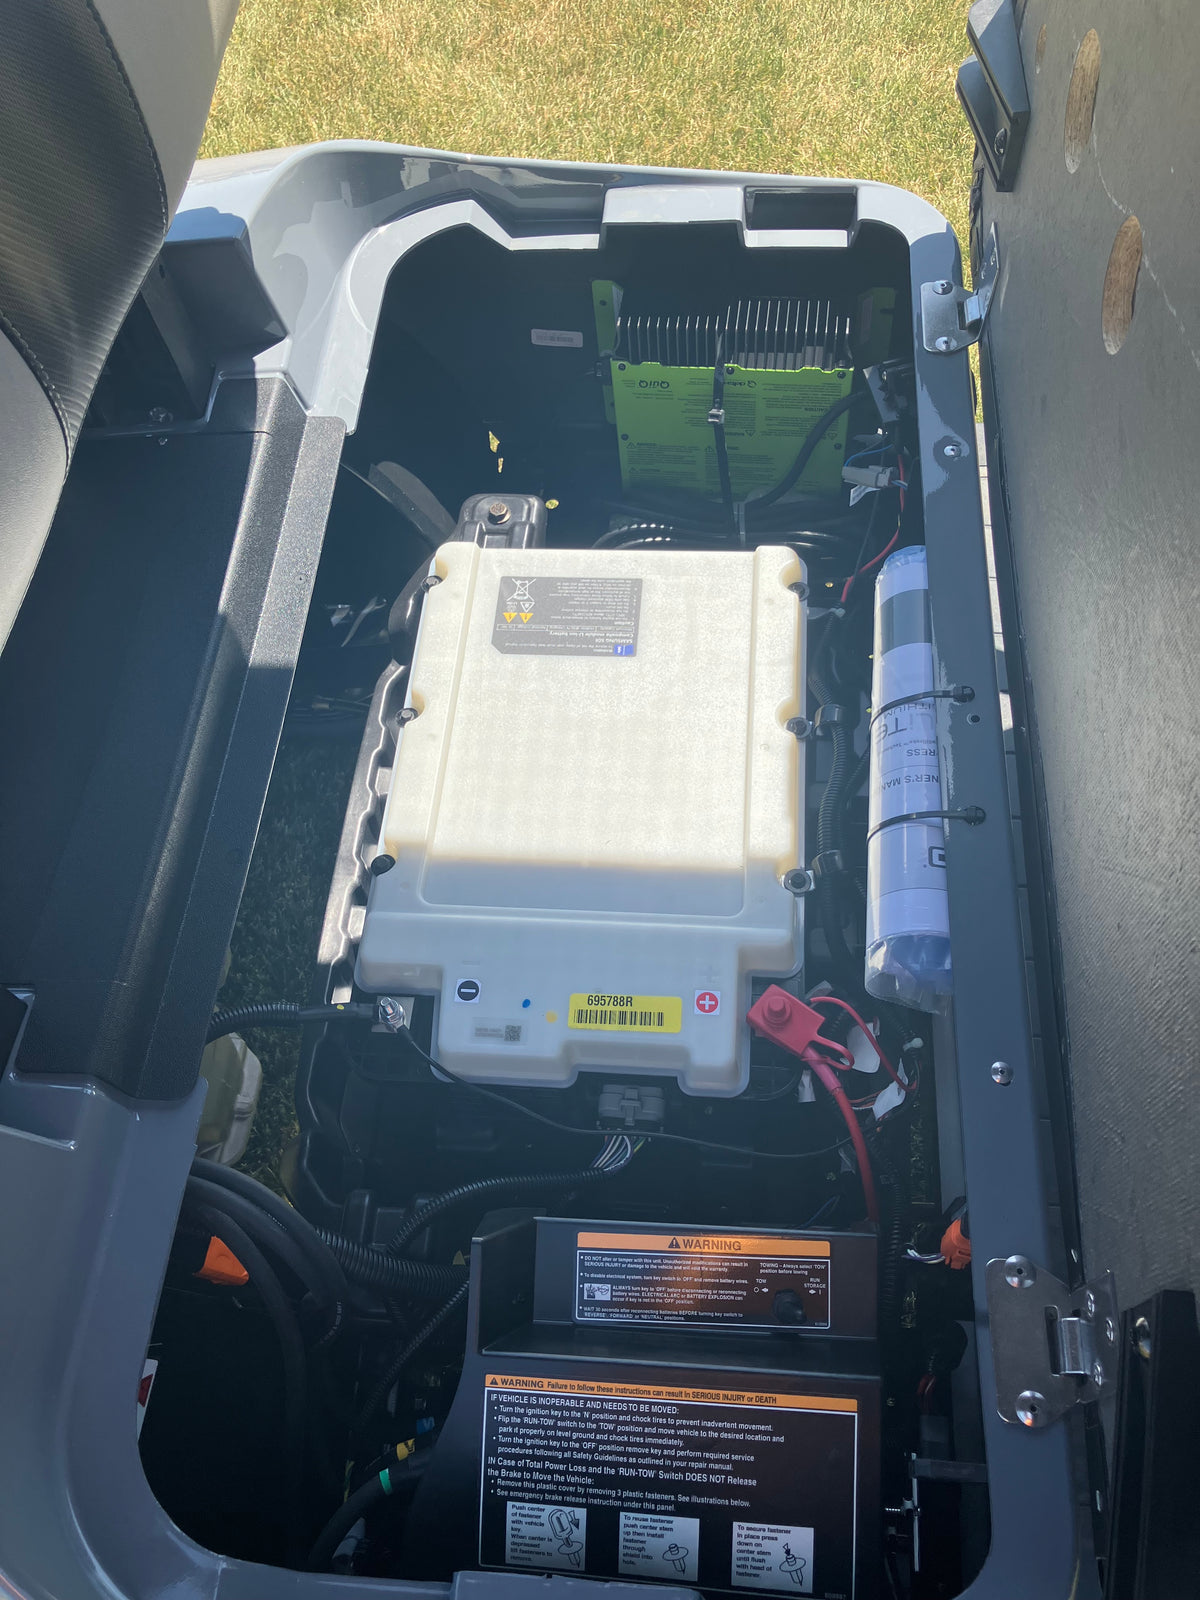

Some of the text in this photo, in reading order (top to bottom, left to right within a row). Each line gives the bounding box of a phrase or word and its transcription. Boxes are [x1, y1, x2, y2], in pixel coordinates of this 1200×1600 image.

[587, 995, 633, 1007] 695788R
[682, 1238, 741, 1251] WARNING
[500, 1378, 776, 1404] WARNING Failure to follow these instructions can result in SERIOUS INJURY or DEATH
[498, 1394, 528, 1403] VEHICLE
[538, 1397, 583, 1407] INOPERABLE
[586, 1400, 601, 1408] AND
[602, 1401, 627, 1410] NEEDS
[628, 1403, 637, 1411] TO
[651, 1405, 678, 1414] MOVED:
[499, 1404, 513, 1412] Turn
[525, 1407, 549, 1415] ignition
[701, 1420, 736, 1428] inadvertent
[738, 1423, 773, 1431] movement.
[498, 1414, 509, 1422] Flip
[676, 1428, 698, 1436] vehicle
[745, 1433, 770, 1441] location
[519, 1428, 545, 1436] properly
[556, 1429, 570, 1437] level
[645, 1436, 683, 1445] immediately.
[524, 1438, 547, 1446] ignition
[497, 1446, 532, 1454] procedures
[534, 1448, 562, 1456] following
[572, 1451, 592, 1459] Safety
[593, 1453, 627, 1462] Guidelines
[637, 1456, 663, 1465] outlined
[487, 1456, 495, 1464] IN
[497, 1457, 515, 1466] Case
[525, 1459, 542, 1468] Total
[544, 1461, 566, 1470] Power
[568, 1464, 586, 1472] Loss
[603, 1466, 615, 1474] the
[658, 1470, 683, 1480] Switch
[685, 1472, 707, 1481] DOES
[709, 1474, 725, 1483] NOT
[727, 1475, 756, 1485] Release
[487, 1468, 498, 1476] the
[500, 1468, 521, 1477] Brake
[532, 1471, 551, 1480] Move
[553, 1473, 564, 1481] the
[566, 1474, 593, 1484] Vehicle:
[509, 1491, 543, 1499] emergency
[587, 1497, 621, 1506] instruction
[536, 1482, 556, 1490] plastic
[577, 1485, 584, 1494] by
[586, 1487, 615, 1495] removing
[622, 1490, 643, 1498] plastic
[645, 1492, 677, 1500] fasteners.
[677, 1494, 689, 1502] See
[691, 1495, 728, 1505] illustrations
